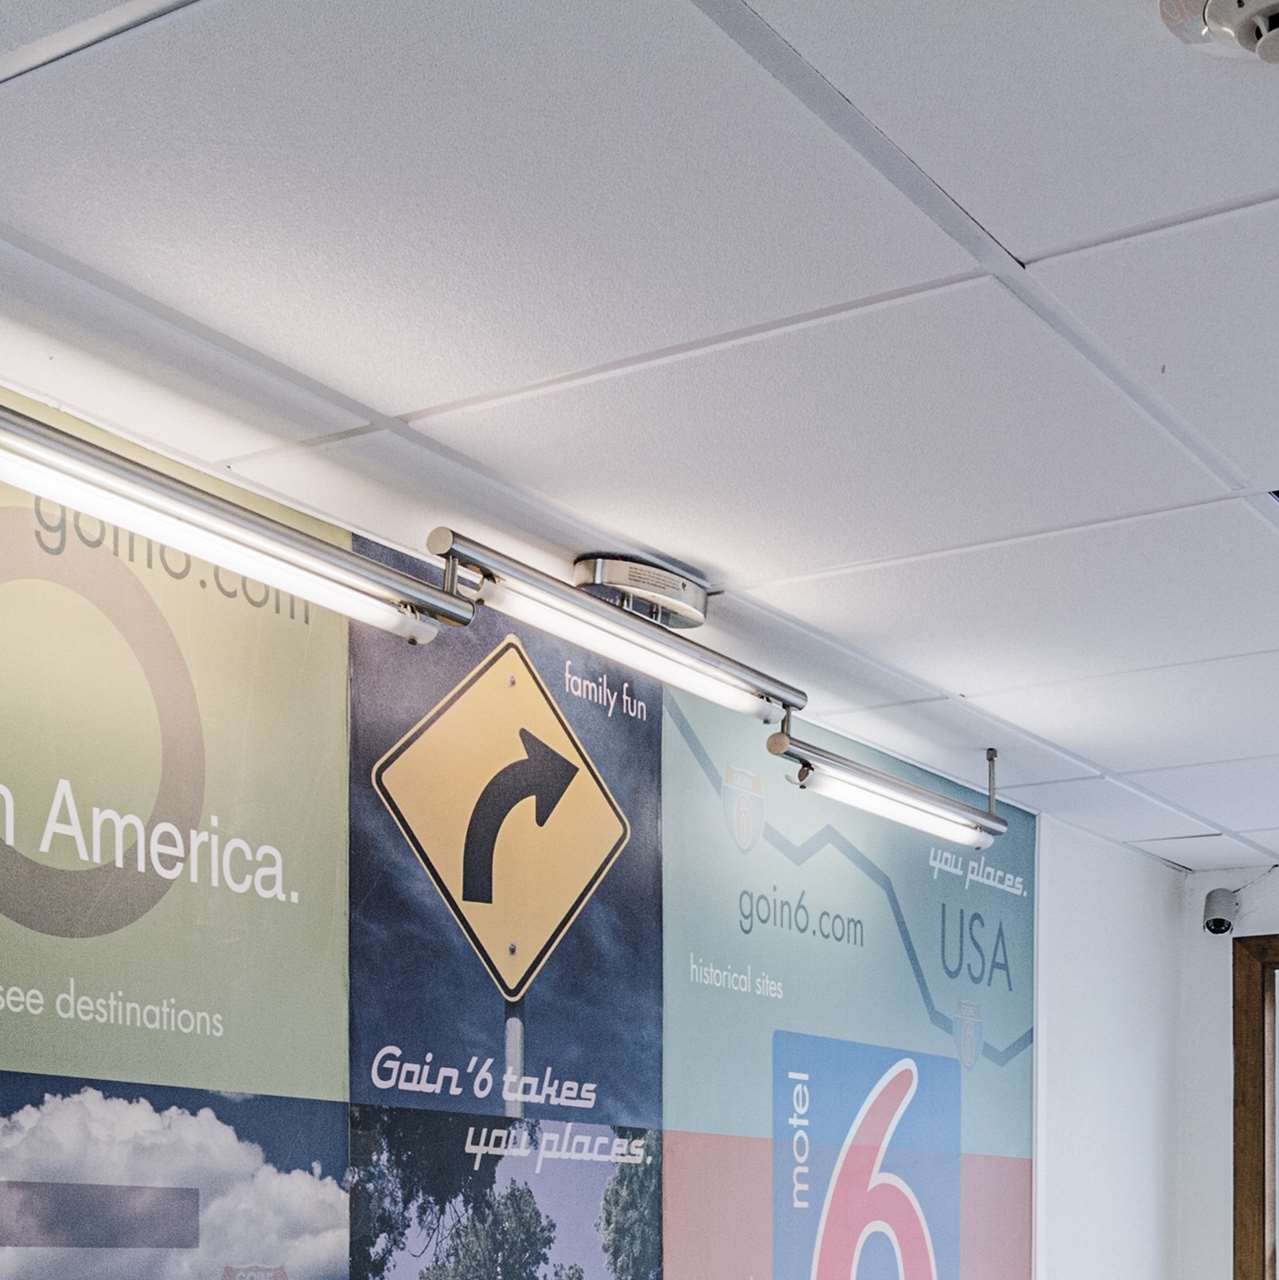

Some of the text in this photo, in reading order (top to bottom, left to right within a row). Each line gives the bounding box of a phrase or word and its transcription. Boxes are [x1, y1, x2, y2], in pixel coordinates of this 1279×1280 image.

[565, 660, 647, 722] family fun
[39, 778, 300, 904] America.
[929, 847, 1028, 897] you places.
[739, 885, 865, 948] goin6.com
[941, 902, 1013, 992] USA
[56, 975, 224, 1038] destinations
[689, 952, 784, 1000] historical sites
[502, 1066, 597, 1109] takes
[465, 1123, 653, 1174] you places.
[788, 1071, 810, 1208] motel
